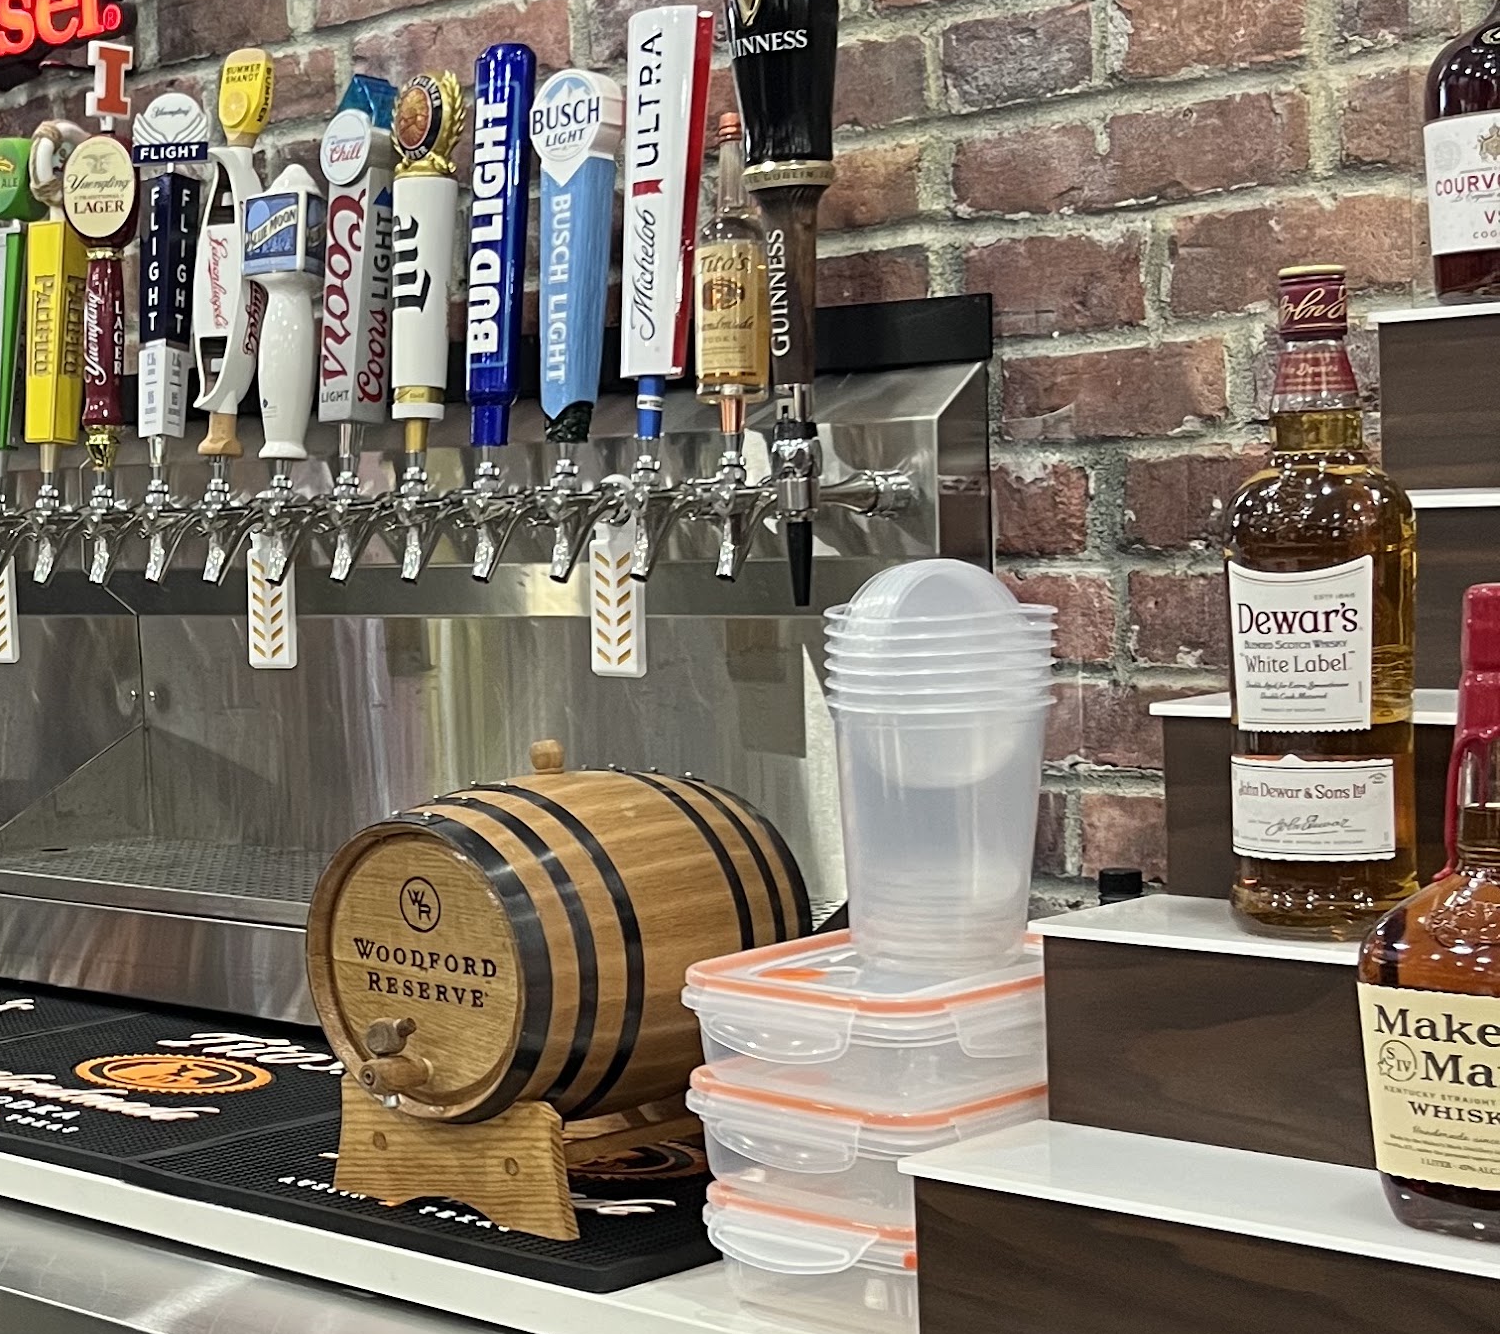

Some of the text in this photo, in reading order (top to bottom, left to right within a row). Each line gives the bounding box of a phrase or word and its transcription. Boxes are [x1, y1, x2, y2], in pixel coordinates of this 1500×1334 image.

[729, 28, 809, 59] UINNESS
[533, 97, 601, 136] BUSCH
[636, 28, 664, 169] ULTRA
[139, 144, 200, 161] FLIGHT
[545, 128, 585, 148] LIGHT
[66, 174, 131, 196] Yuengling
[73, 199, 126, 215] LAGER
[467, 97, 509, 355] BUD LIGHT
[147, 186, 161, 333] FLIGHT
[173, 187, 192, 335] FLIGHT
[321, 188, 367, 386] Coors
[545, 193, 572, 385] BUSCH LIGHT
[630, 209, 657, 341] Michelob
[358, 211, 395, 405] Coors LIGHT
[767, 229, 790, 357] GUINNESS
[83, 289, 107, 386] Yuengling
[112, 299, 126, 376] LAGER
[321, 389, 349, 404] LIGHT
[1238, 602, 1358, 635] Dewar's
[1260, 782, 1302, 798] Dewar
[1304, 787, 1313, 799] &
[1314, 783, 1350, 799] Sons
[353, 938, 498, 979] WOODFORD
[367, 971, 488, 1008] RESERVE
